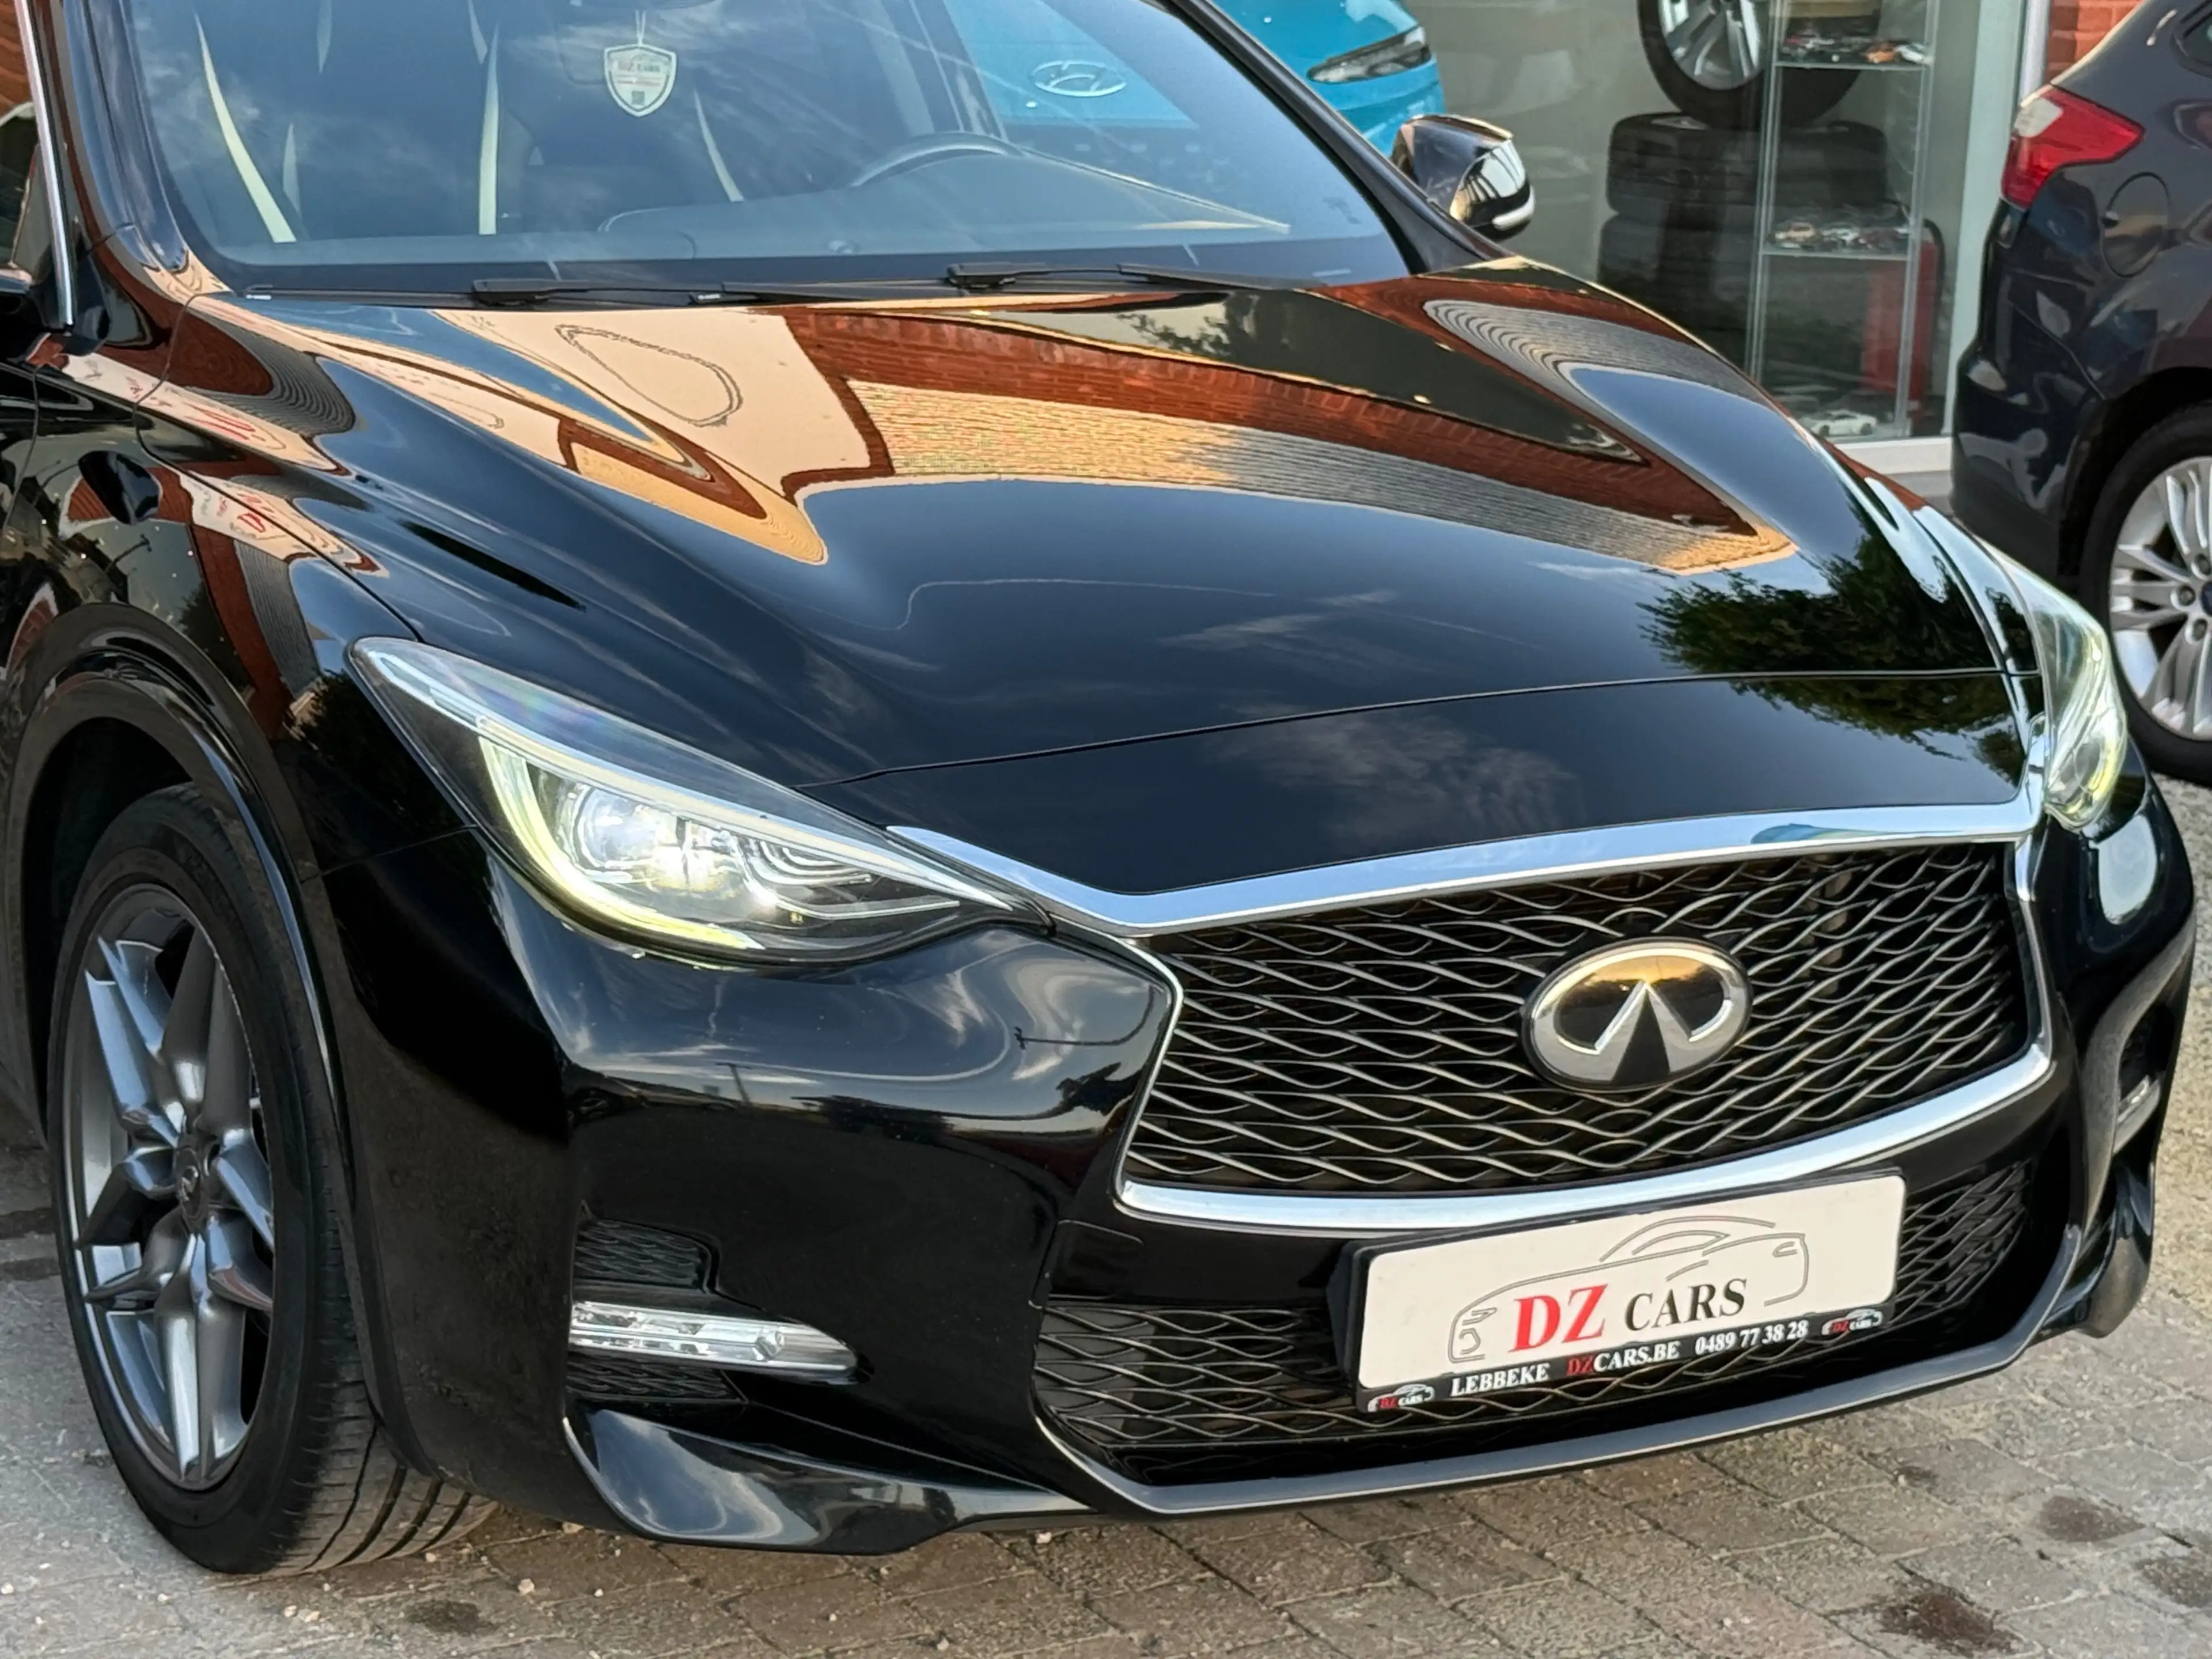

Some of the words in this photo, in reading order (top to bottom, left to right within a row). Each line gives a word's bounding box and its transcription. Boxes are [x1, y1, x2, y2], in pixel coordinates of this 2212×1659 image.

[1508, 1283, 1608, 1353] DZ
[1624, 1278, 1747, 1332] CARS
[1450, 1362, 1550, 1397] LEBBEKE
[1566, 1340, 1681, 1377] DZCARS.BE
[1695, 1331, 1737, 1355] 0489
[1739, 1327, 1761, 1348] 77
[1762, 1323, 1785, 1344] 38
[1786, 1320, 1809, 1340] 28
